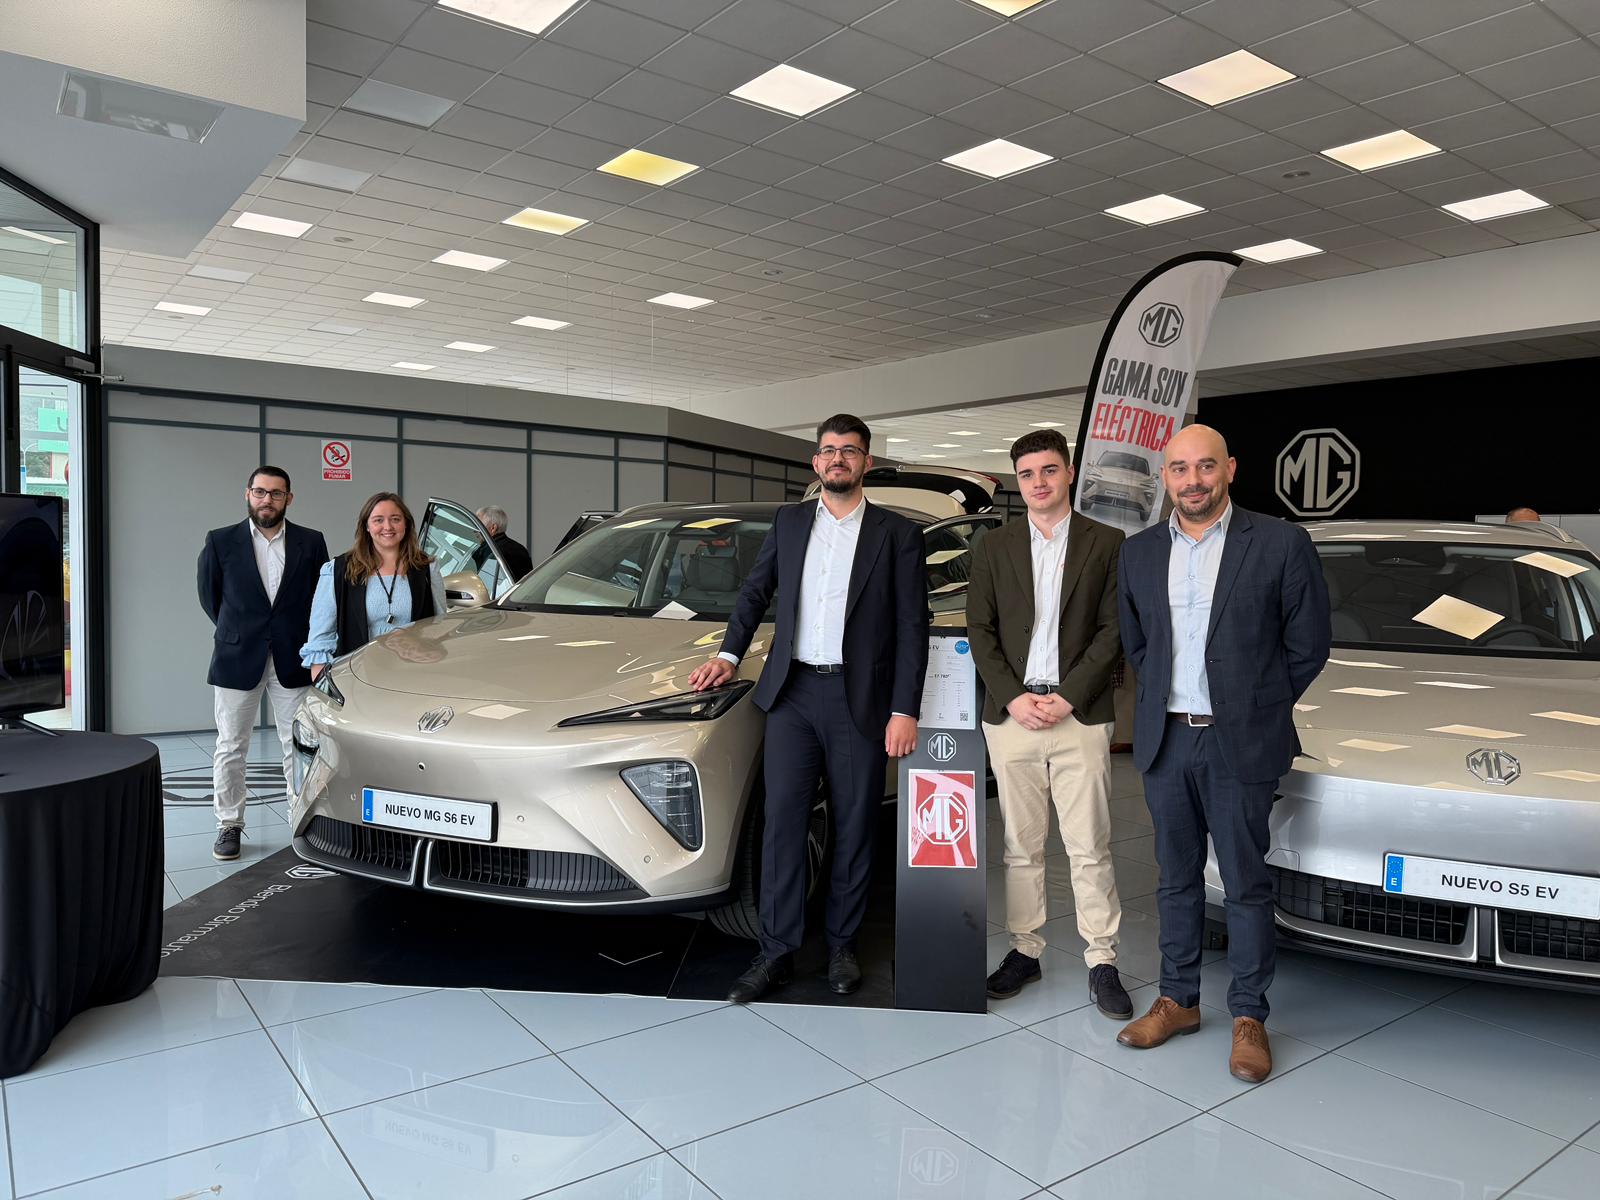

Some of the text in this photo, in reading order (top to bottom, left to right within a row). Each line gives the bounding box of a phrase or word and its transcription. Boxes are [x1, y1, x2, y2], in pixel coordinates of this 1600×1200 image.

[1142, 305, 1182, 345] MG
[1102, 358, 1153, 400] GAMA
[1091, 399, 1175, 453] ELÉCTRICA
[1280, 434, 1355, 511] MG
[420, 707, 452, 732] MG
[930, 735, 955, 760] MG
[1469, 750, 1518, 783] MG
[385, 804, 475, 826] NUEVO MG S6 EV
[921, 796, 965, 842] MG
[1391, 878, 1397, 886] E
[1441, 874, 1559, 900] NUEVO S5 EV
[228, 884, 292, 914] Blendio
